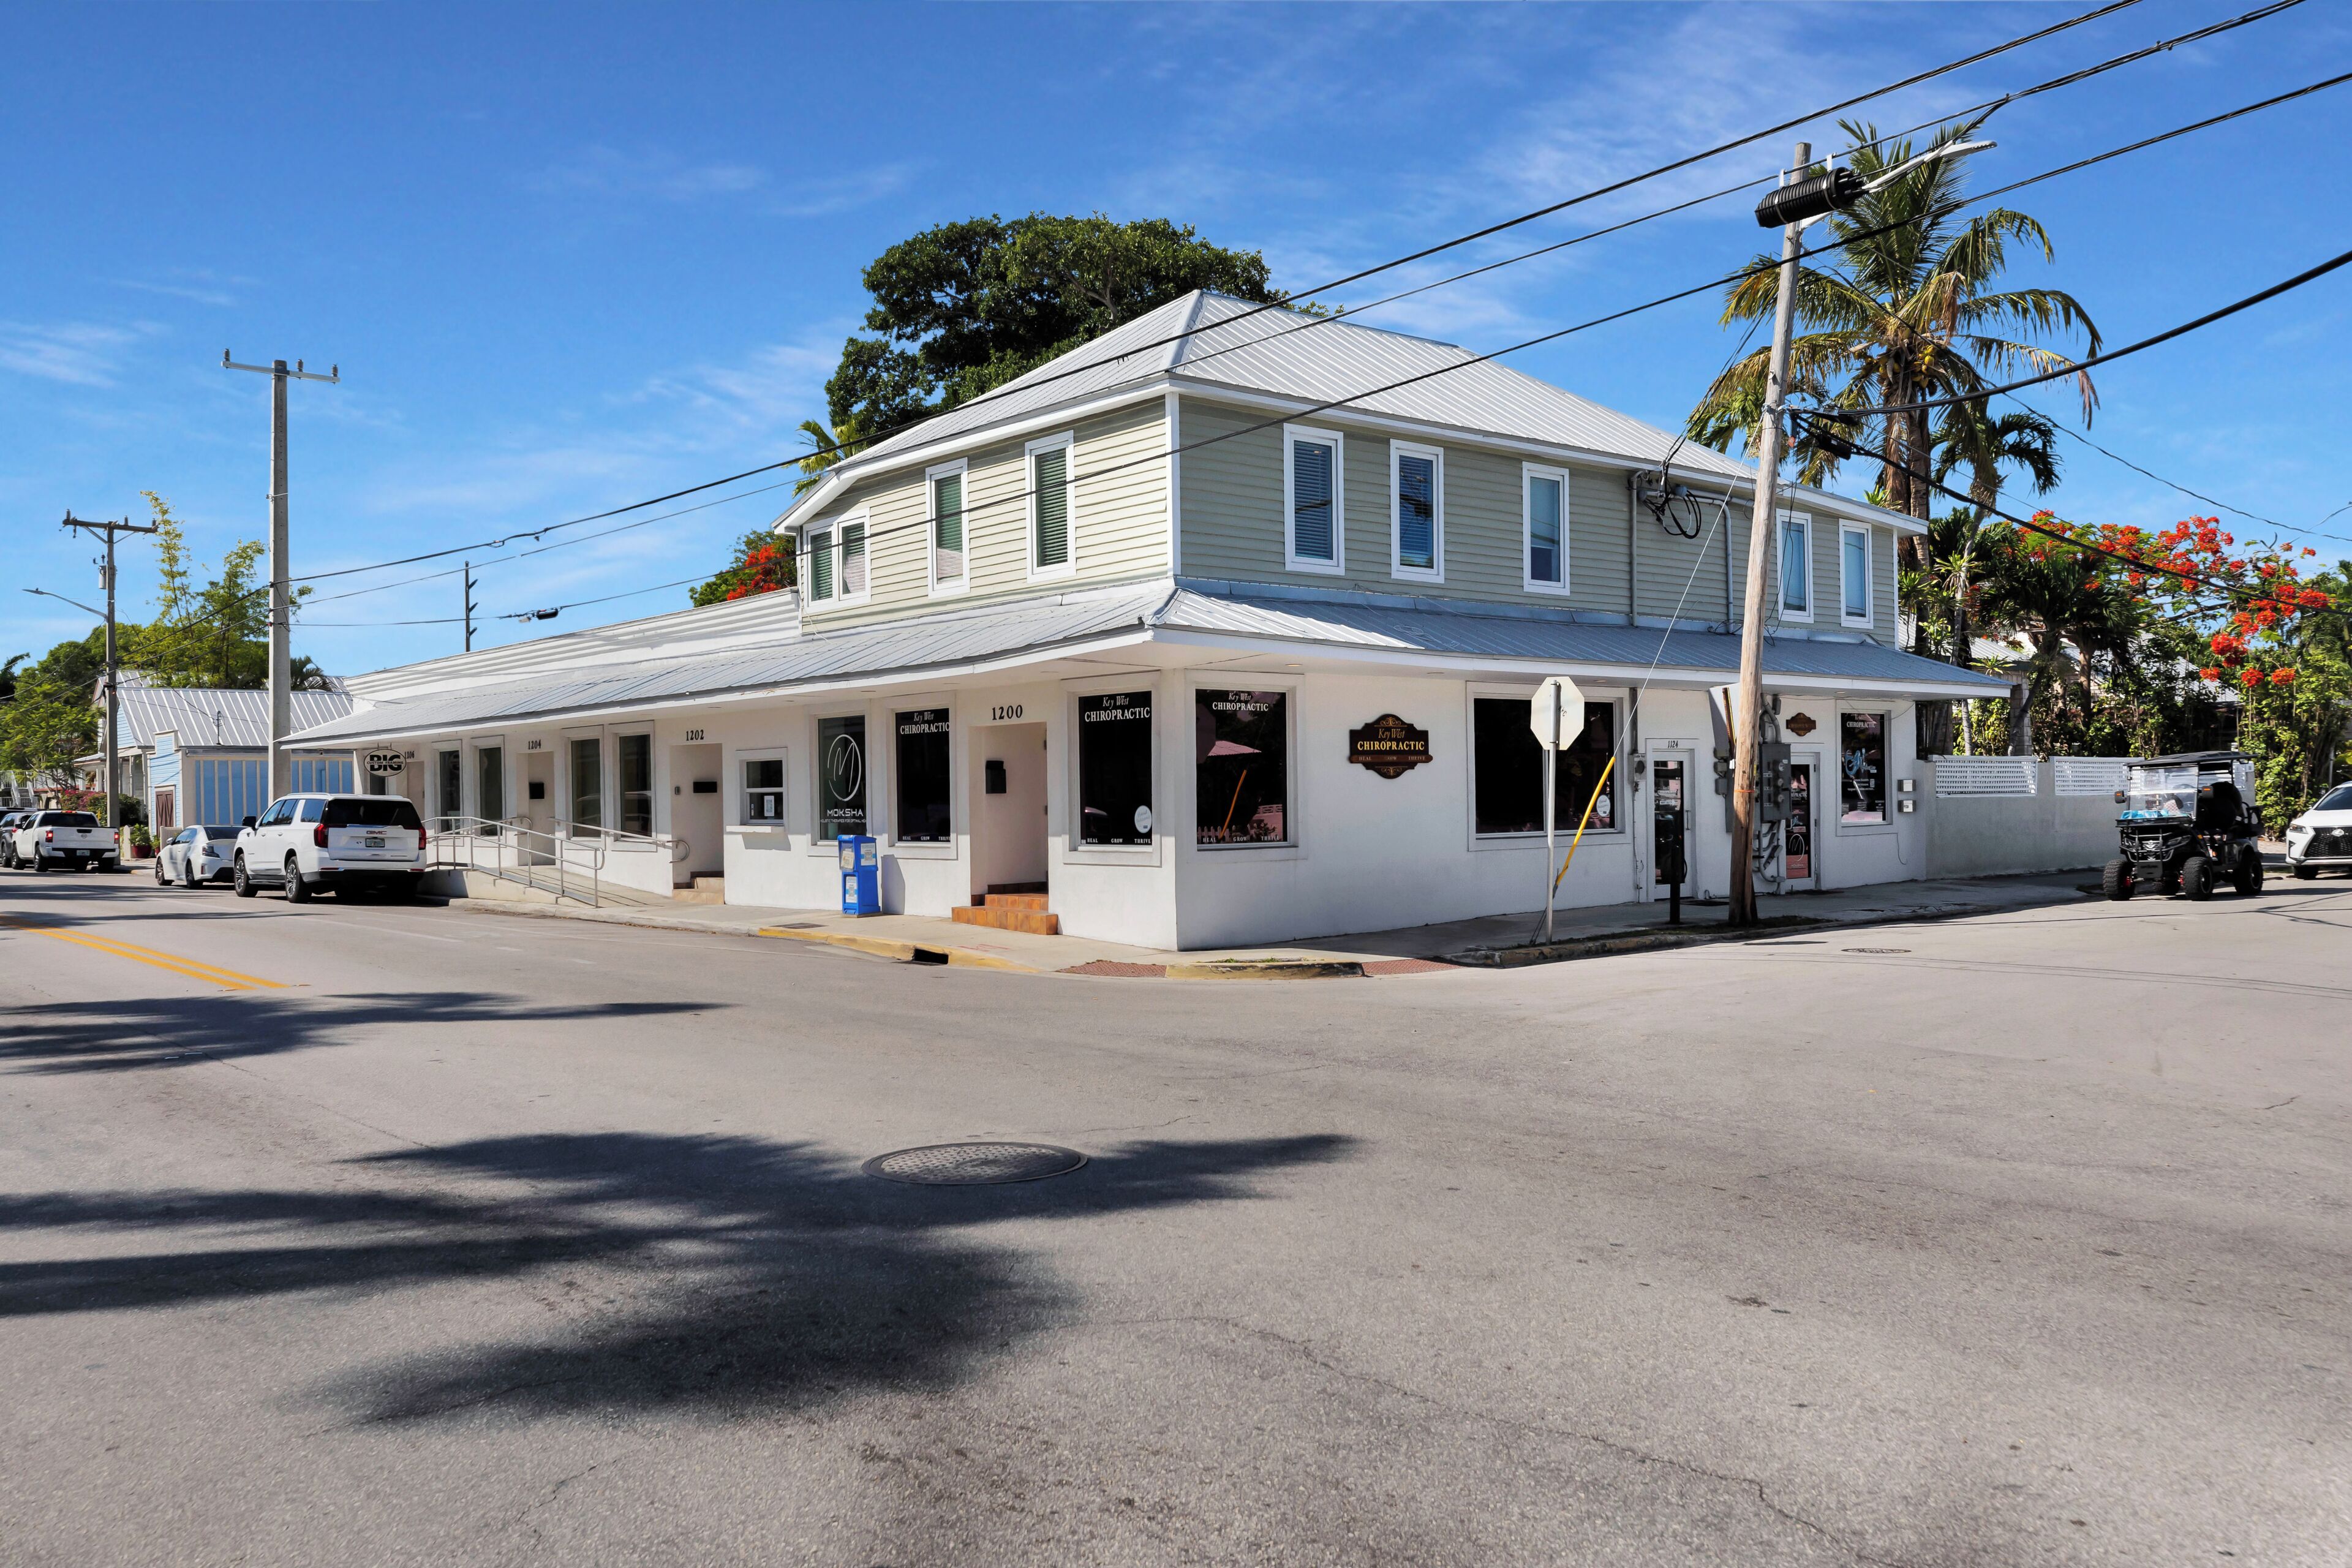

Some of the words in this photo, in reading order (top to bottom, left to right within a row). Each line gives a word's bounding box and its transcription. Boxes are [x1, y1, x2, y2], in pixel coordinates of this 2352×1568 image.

[1102, 697, 1114, 709] Key
[1116, 695, 1129, 706] West
[1229, 692, 1238, 702] Key
[992, 704, 1023, 720] 1200
[1212, 702, 1268, 711] CHIROPRACTIC
[914, 712, 922, 723] Key
[924, 712, 933, 720] West
[1085, 707, 1150, 722] CHIROPRACTIC
[686, 729, 704, 741] 1202
[1378, 728, 1390, 741] Key
[1391, 728, 1405, 739] West
[528, 739, 541, 750] 1204
[1357, 741, 1425, 750] CHIROPRACTIC
[404, 750, 415, 760] 1206
[369, 754, 402, 772] BIG
